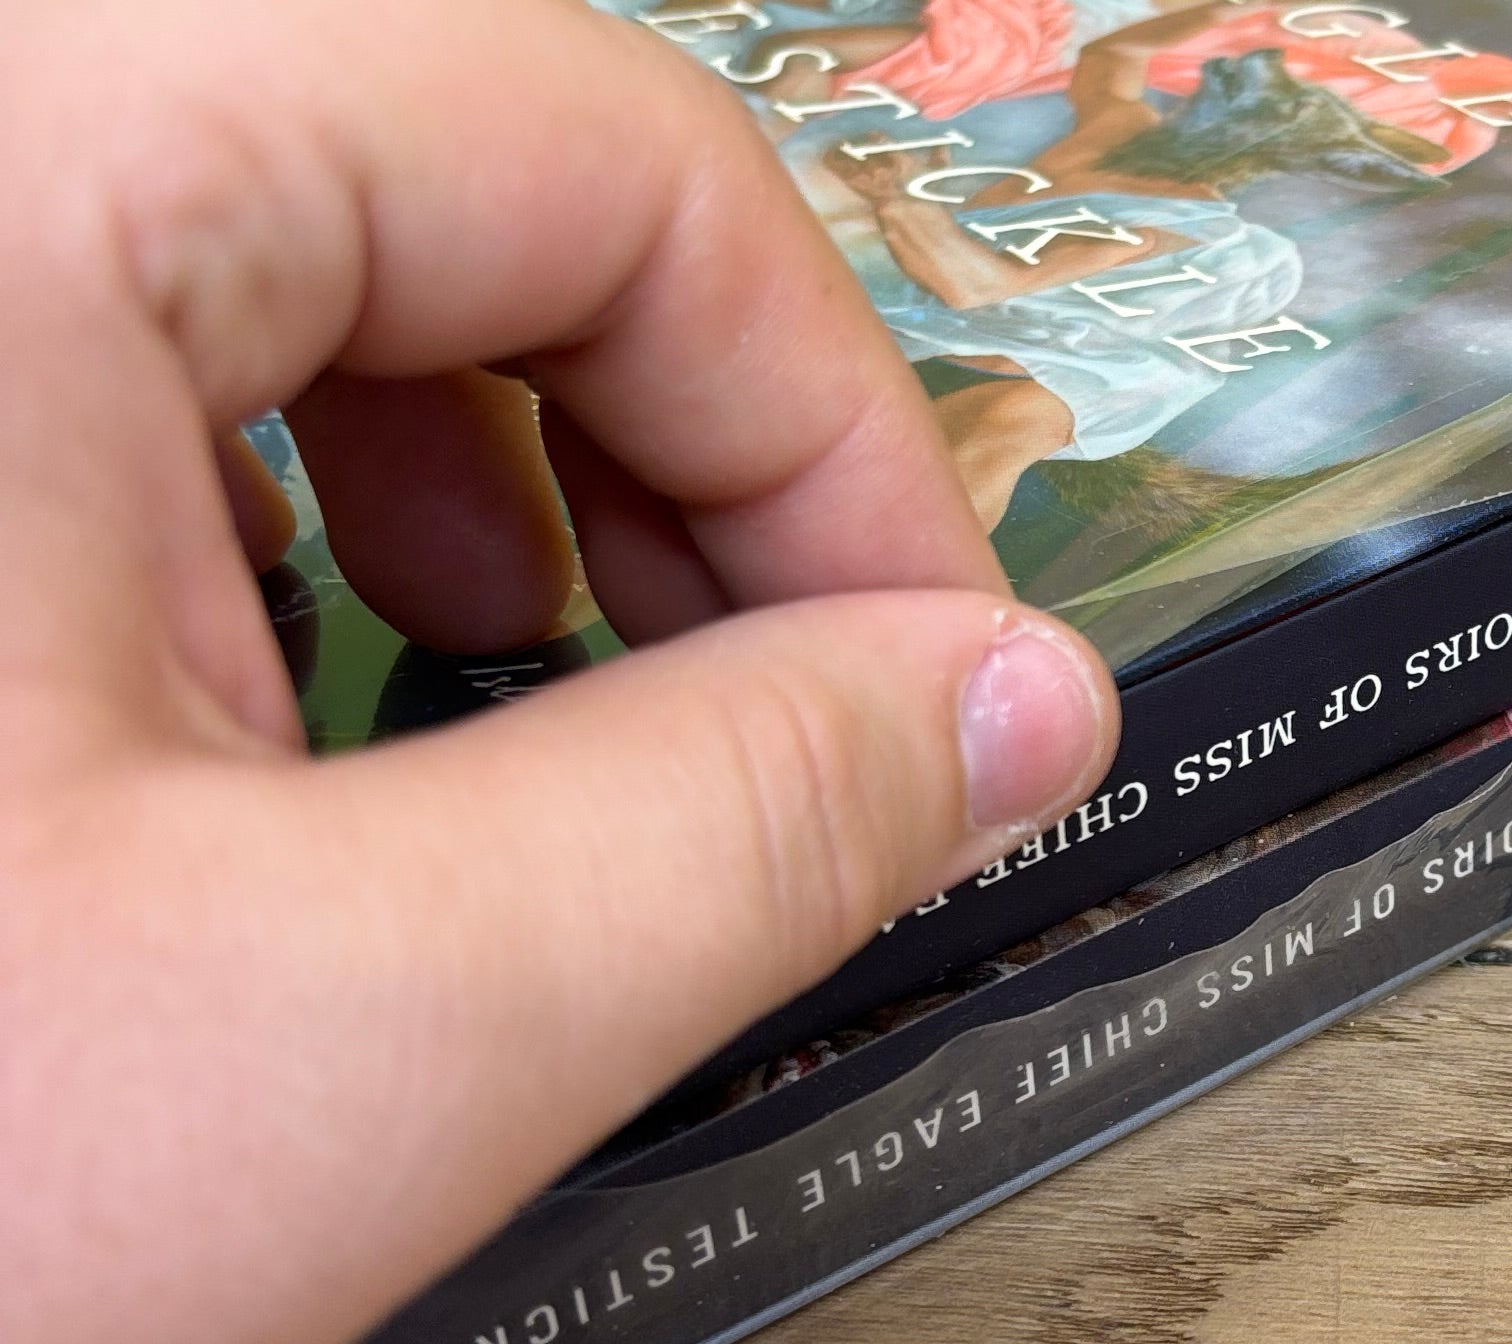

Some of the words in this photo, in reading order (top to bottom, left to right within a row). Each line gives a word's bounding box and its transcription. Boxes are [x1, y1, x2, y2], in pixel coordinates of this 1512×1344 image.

[1319, 673, 1383, 730] OF
[1172, 710, 1298, 797] MISS
[1342, 882, 1397, 937] OF
[1196, 921, 1315, 1010] MISS
[1014, 997, 1169, 1105] CHIEF
[796, 1089, 983, 1214] EAGLE
